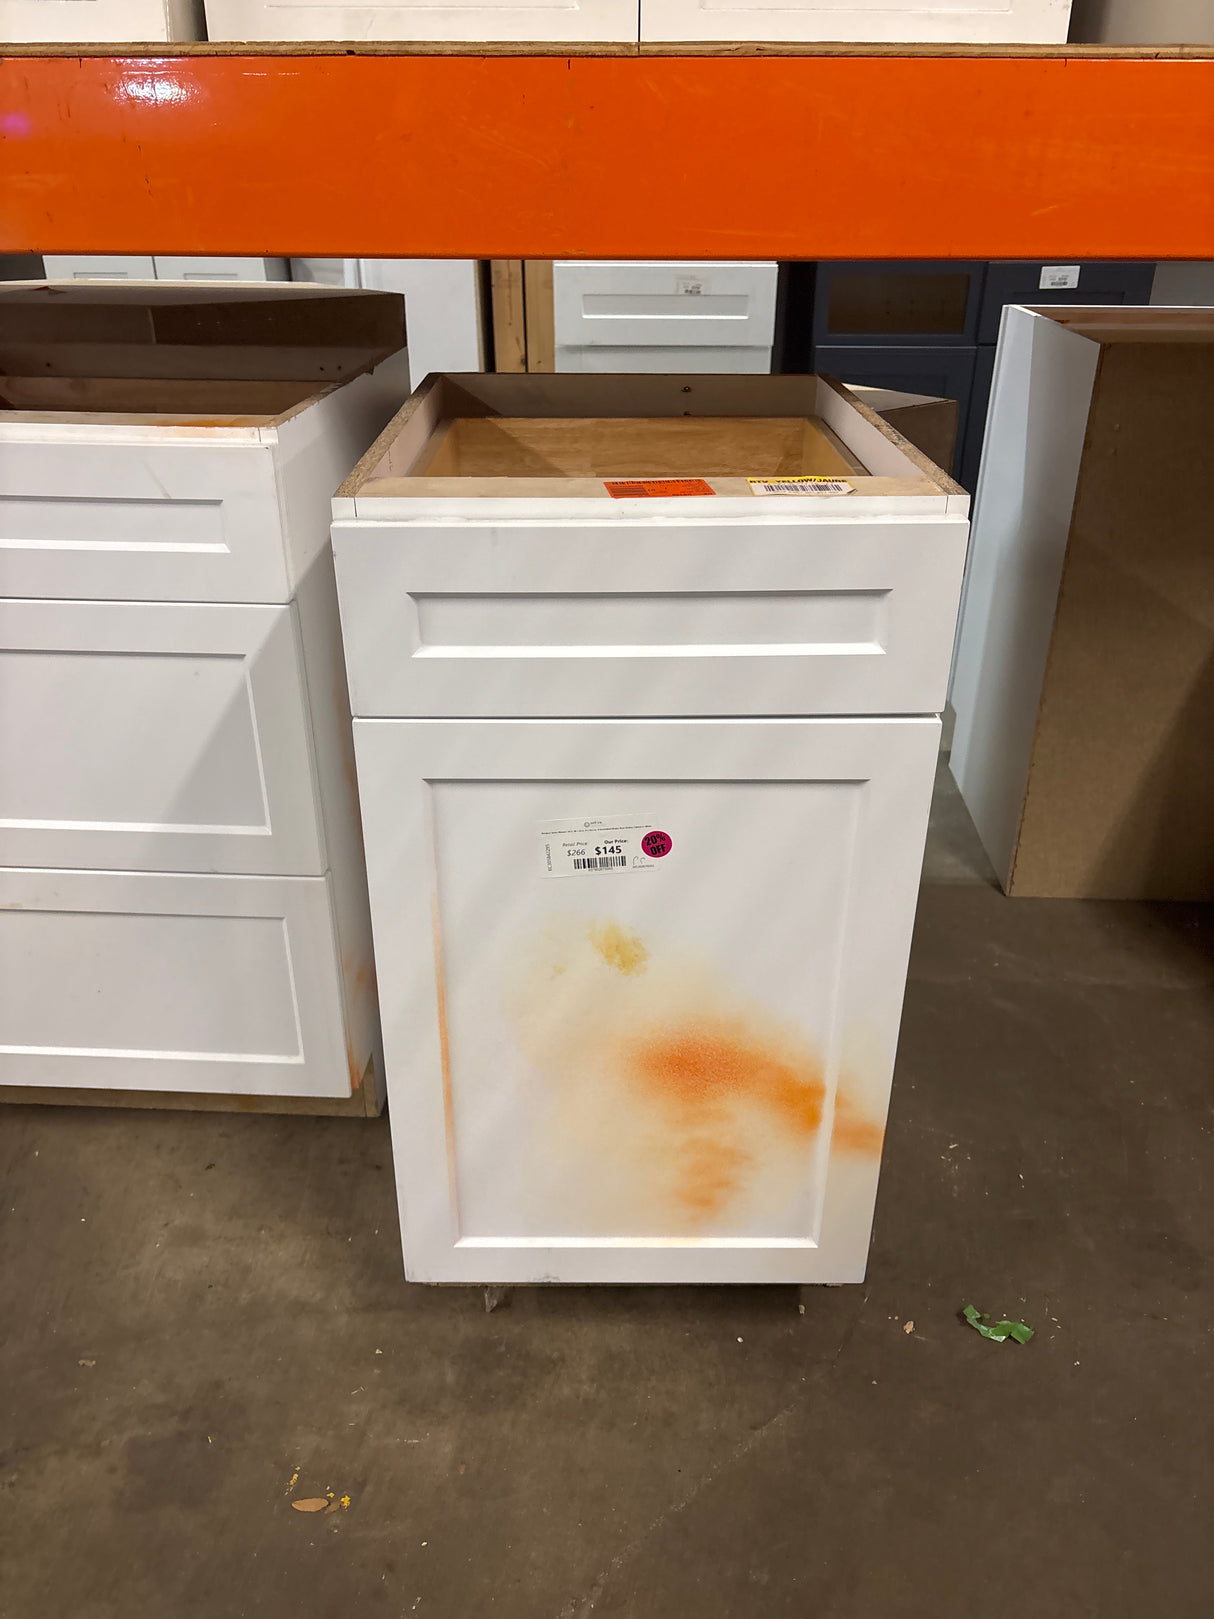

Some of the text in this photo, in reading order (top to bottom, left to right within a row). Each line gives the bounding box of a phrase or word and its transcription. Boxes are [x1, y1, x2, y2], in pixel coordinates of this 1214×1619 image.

[645, 834, 666, 847] 20%
[567, 849, 586, 857] $266
[595, 845, 622, 856] $145
[650, 843, 666, 856] OFF
